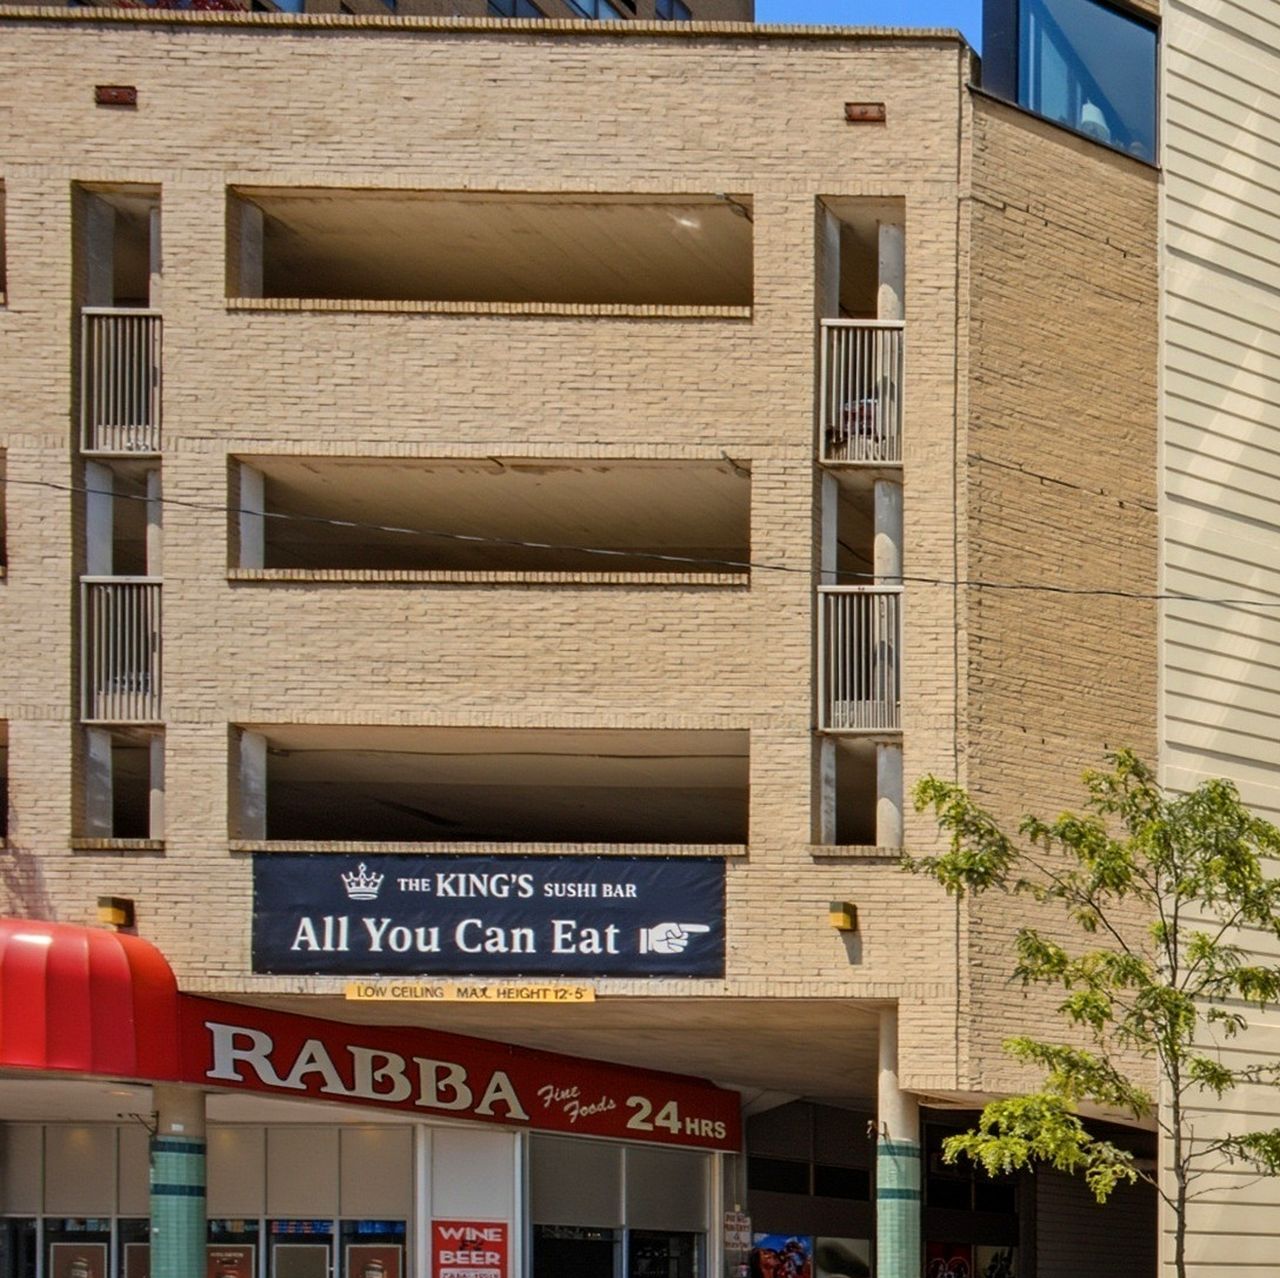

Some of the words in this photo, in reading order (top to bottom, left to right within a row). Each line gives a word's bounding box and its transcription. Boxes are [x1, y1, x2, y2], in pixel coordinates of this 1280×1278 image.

[397, 877, 431, 893] THE
[435, 872, 535, 899] KING'S
[543, 881, 597, 898] SUSHI
[602, 883, 638, 899] BAR
[290, 915, 350, 952] All
[363, 916, 441, 954] You
[455, 917, 536, 954] Can
[551, 918, 621, 955] Eat
[356, 986, 388, 998] LOW
[390, 986, 445, 999] CEILING
[497, 987, 551, 1000] HEIGHT
[204, 1021, 530, 1121] RABBA
[537, 1083, 581, 1109] Fine
[562, 1096, 617, 1123] Foods
[626, 1095, 683, 1135] 24
[684, 1115, 727, 1140] HRS
[438, 1226, 503, 1242] WINE
[439, 1250, 501, 1265] BEER
